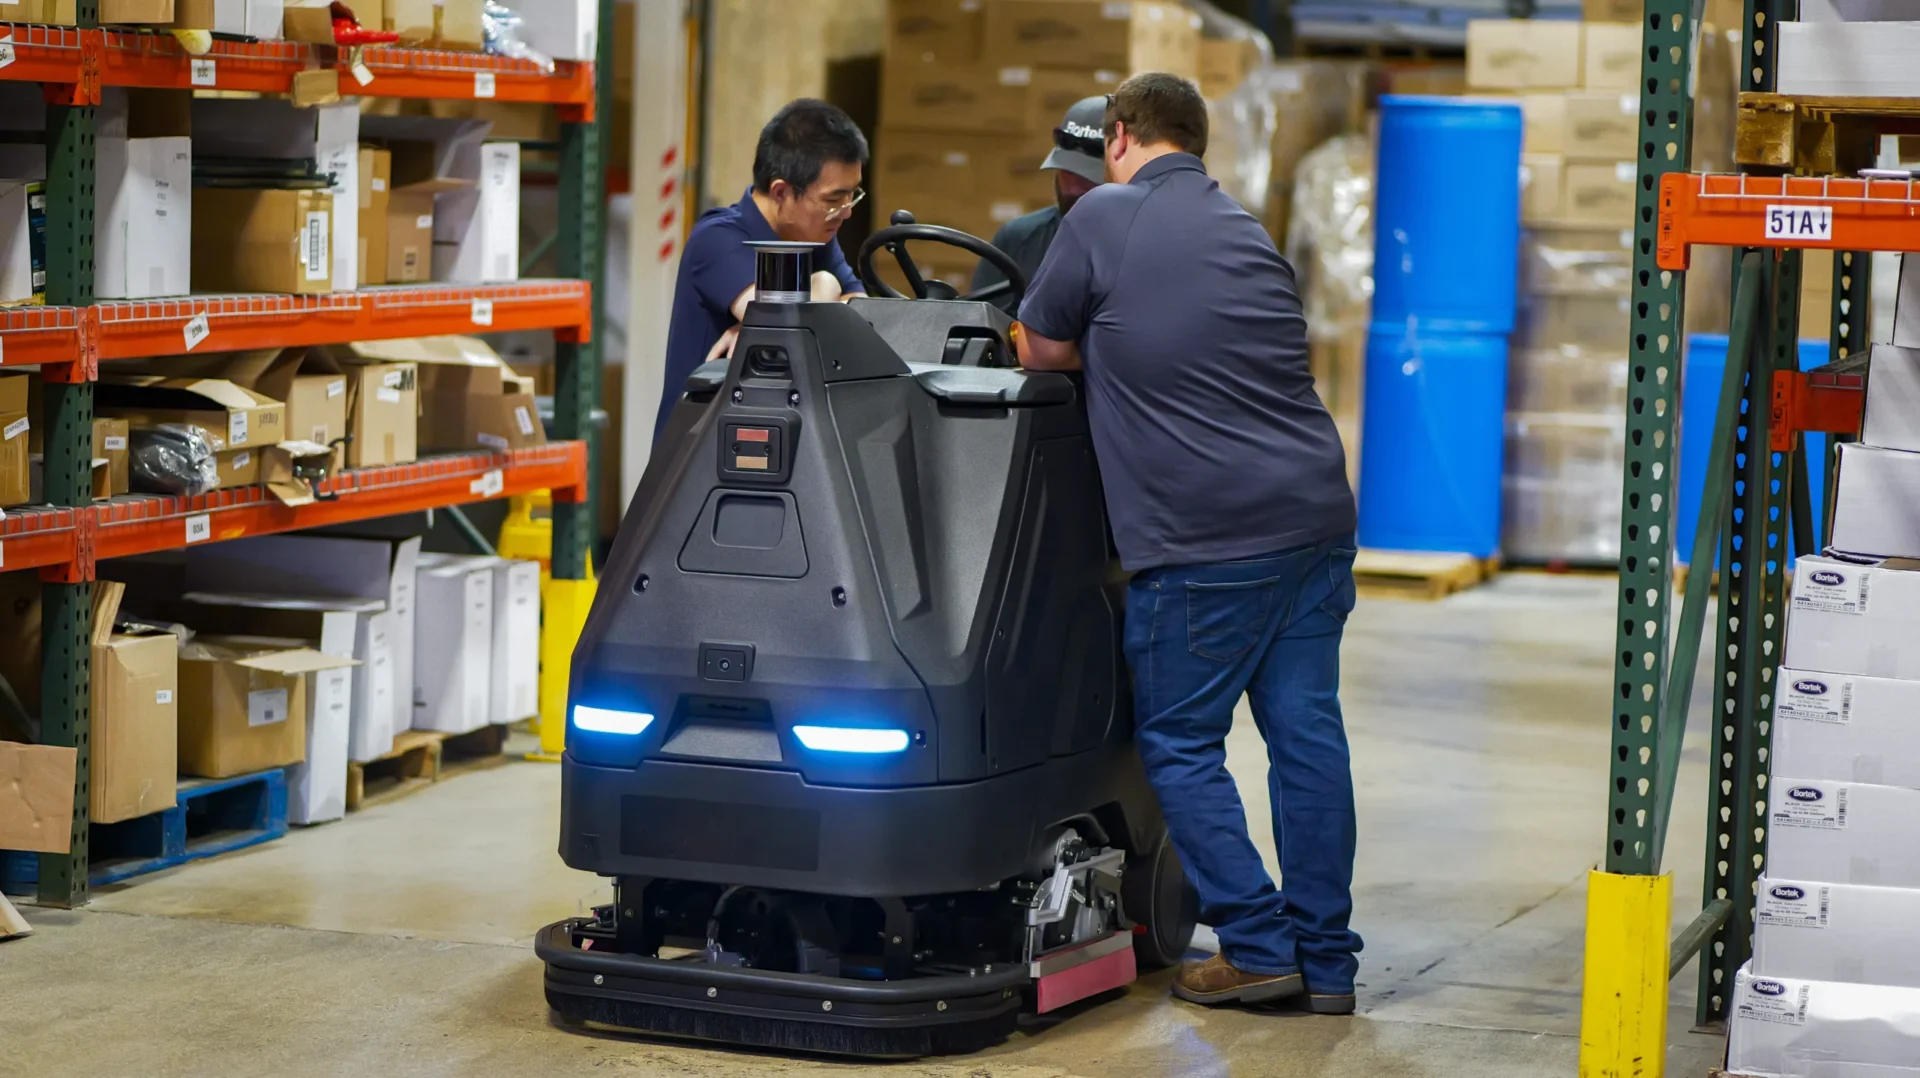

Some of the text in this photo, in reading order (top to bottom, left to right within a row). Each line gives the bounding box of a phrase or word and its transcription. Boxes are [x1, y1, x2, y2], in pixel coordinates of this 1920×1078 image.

[1770, 209, 1814, 234] 51A
[1815, 573, 1839, 584] Bortek
[1798, 682, 1822, 693] Bortek
[1794, 790, 1817, 799] Bortek
[1776, 888, 1799, 898] Bortek
[1756, 983, 1780, 994] Bortek
